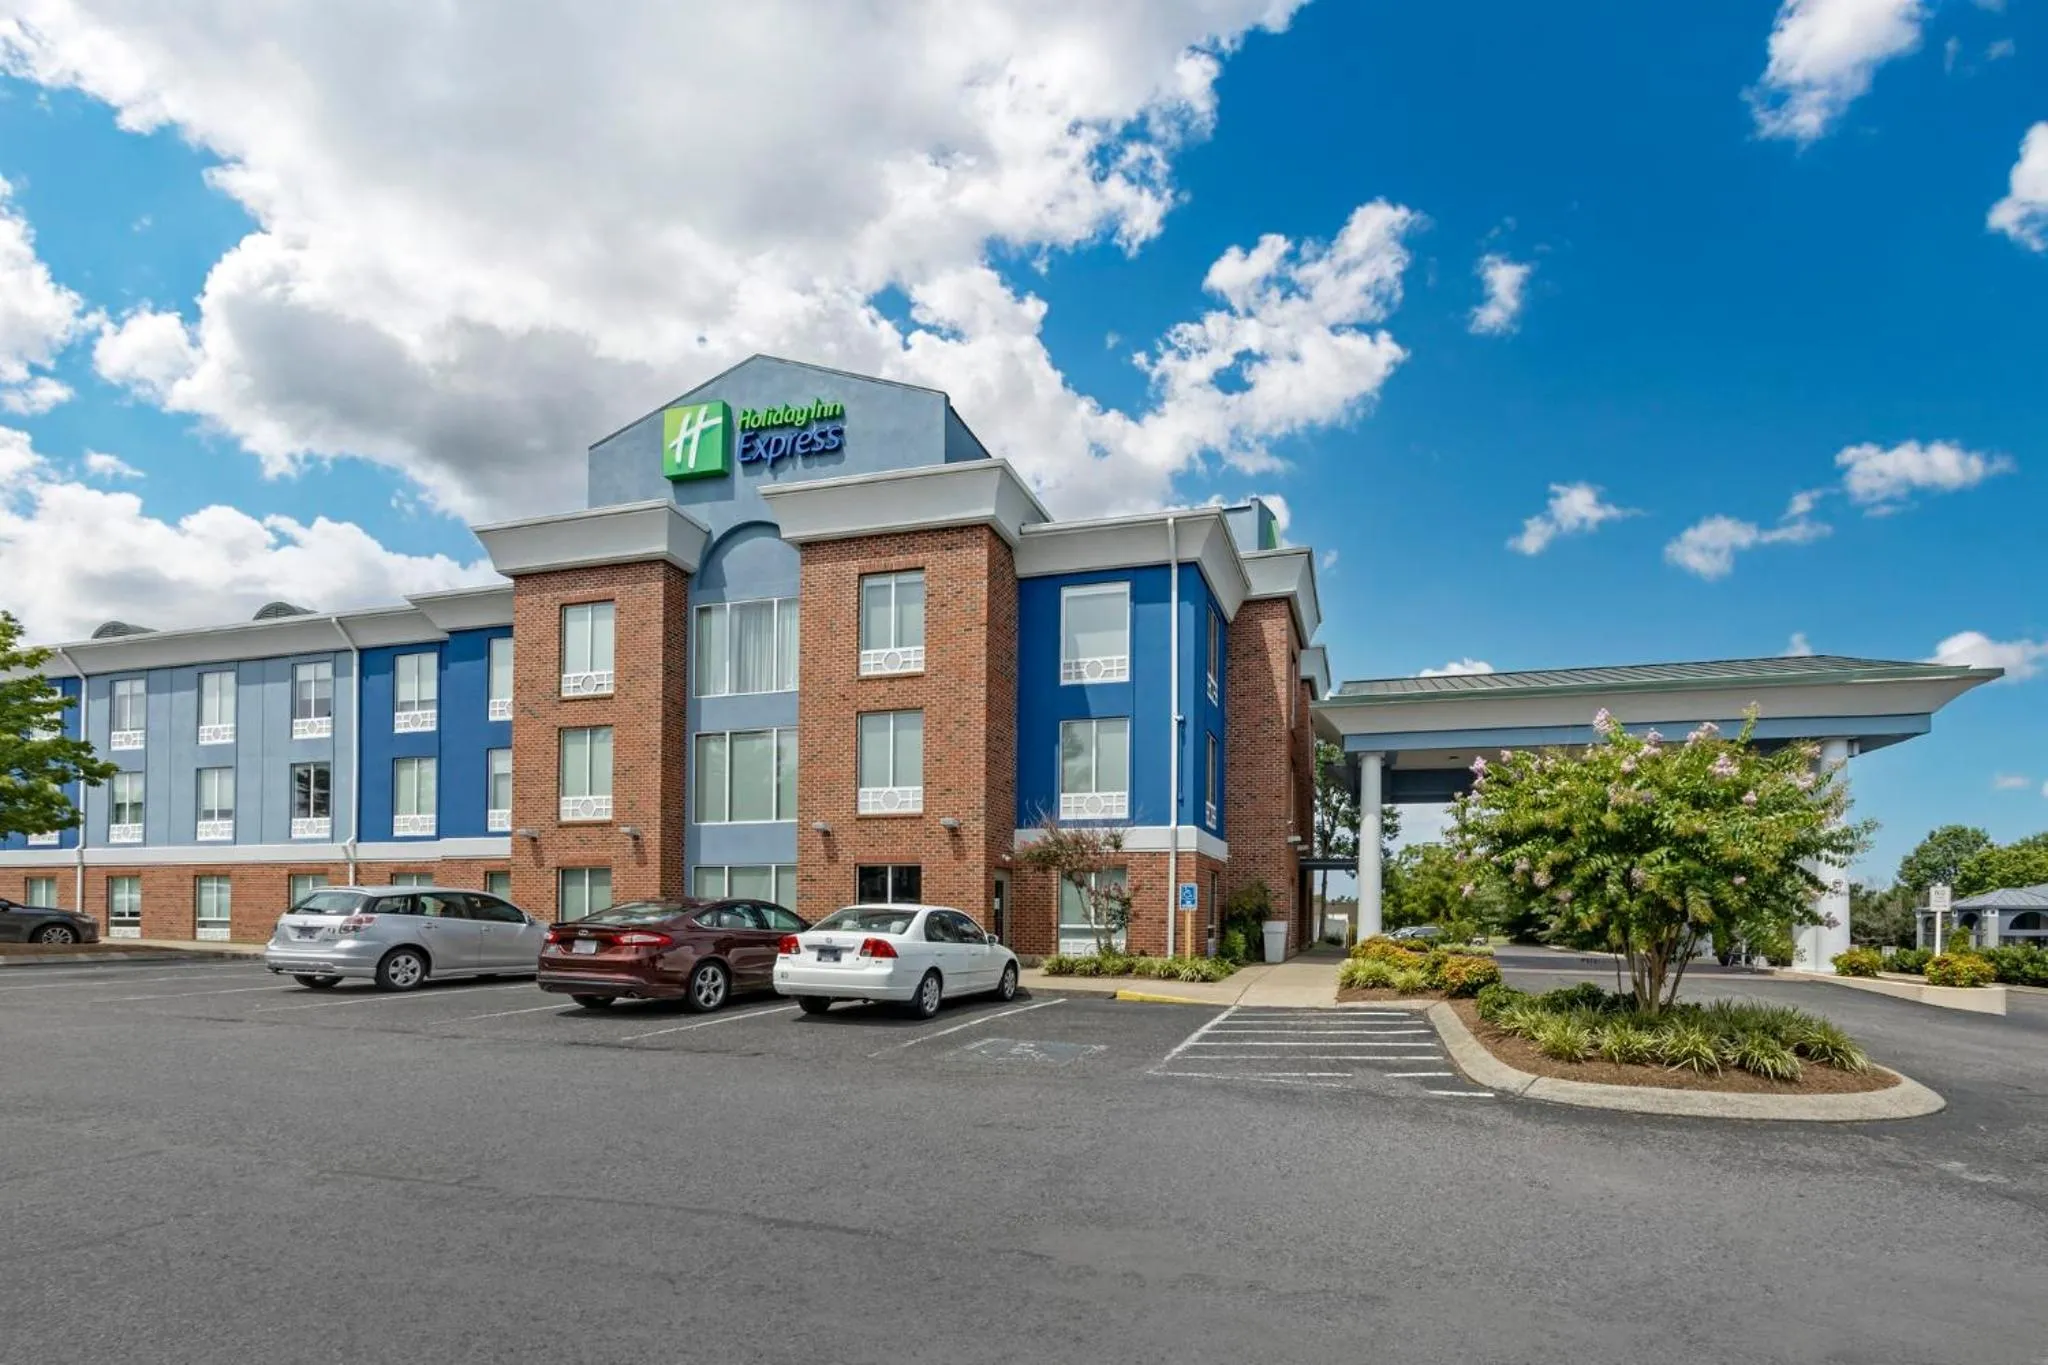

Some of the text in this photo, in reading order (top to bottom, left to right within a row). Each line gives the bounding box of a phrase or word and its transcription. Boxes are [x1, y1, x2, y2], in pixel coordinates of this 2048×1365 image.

[738, 398, 843, 429] Holiday Inn
[737, 424, 844, 467] Express
